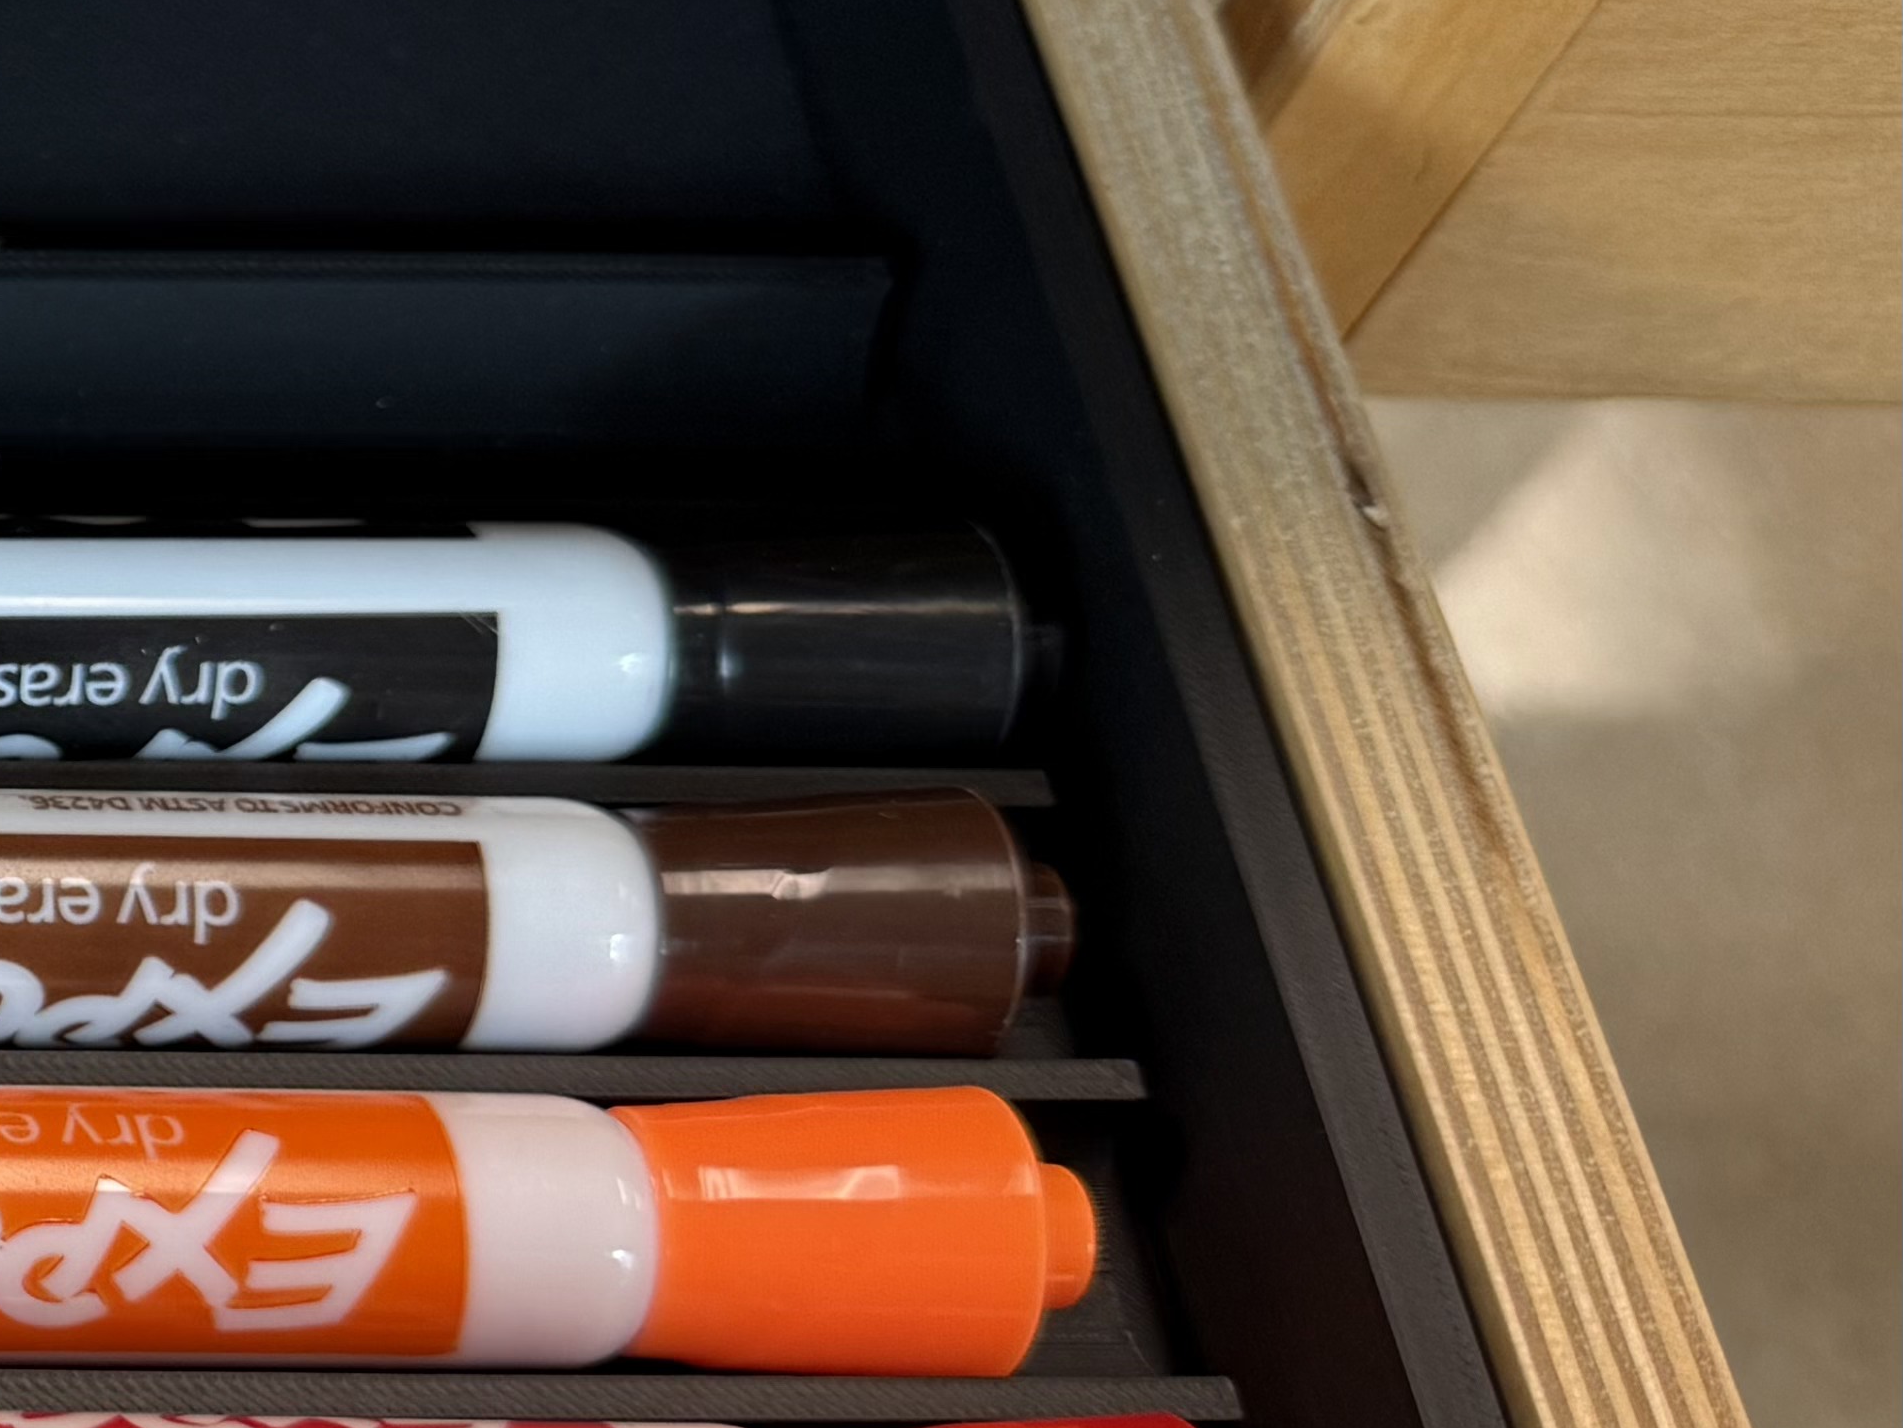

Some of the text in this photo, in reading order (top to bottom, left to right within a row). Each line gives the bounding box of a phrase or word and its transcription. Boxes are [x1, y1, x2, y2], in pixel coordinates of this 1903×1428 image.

[142, 644, 265, 722] dry
[19, 793, 464, 817] CONFORMS TO ASTM D4236.
[117, 862, 240, 946] dry
[61, 1116, 187, 1162] dry
